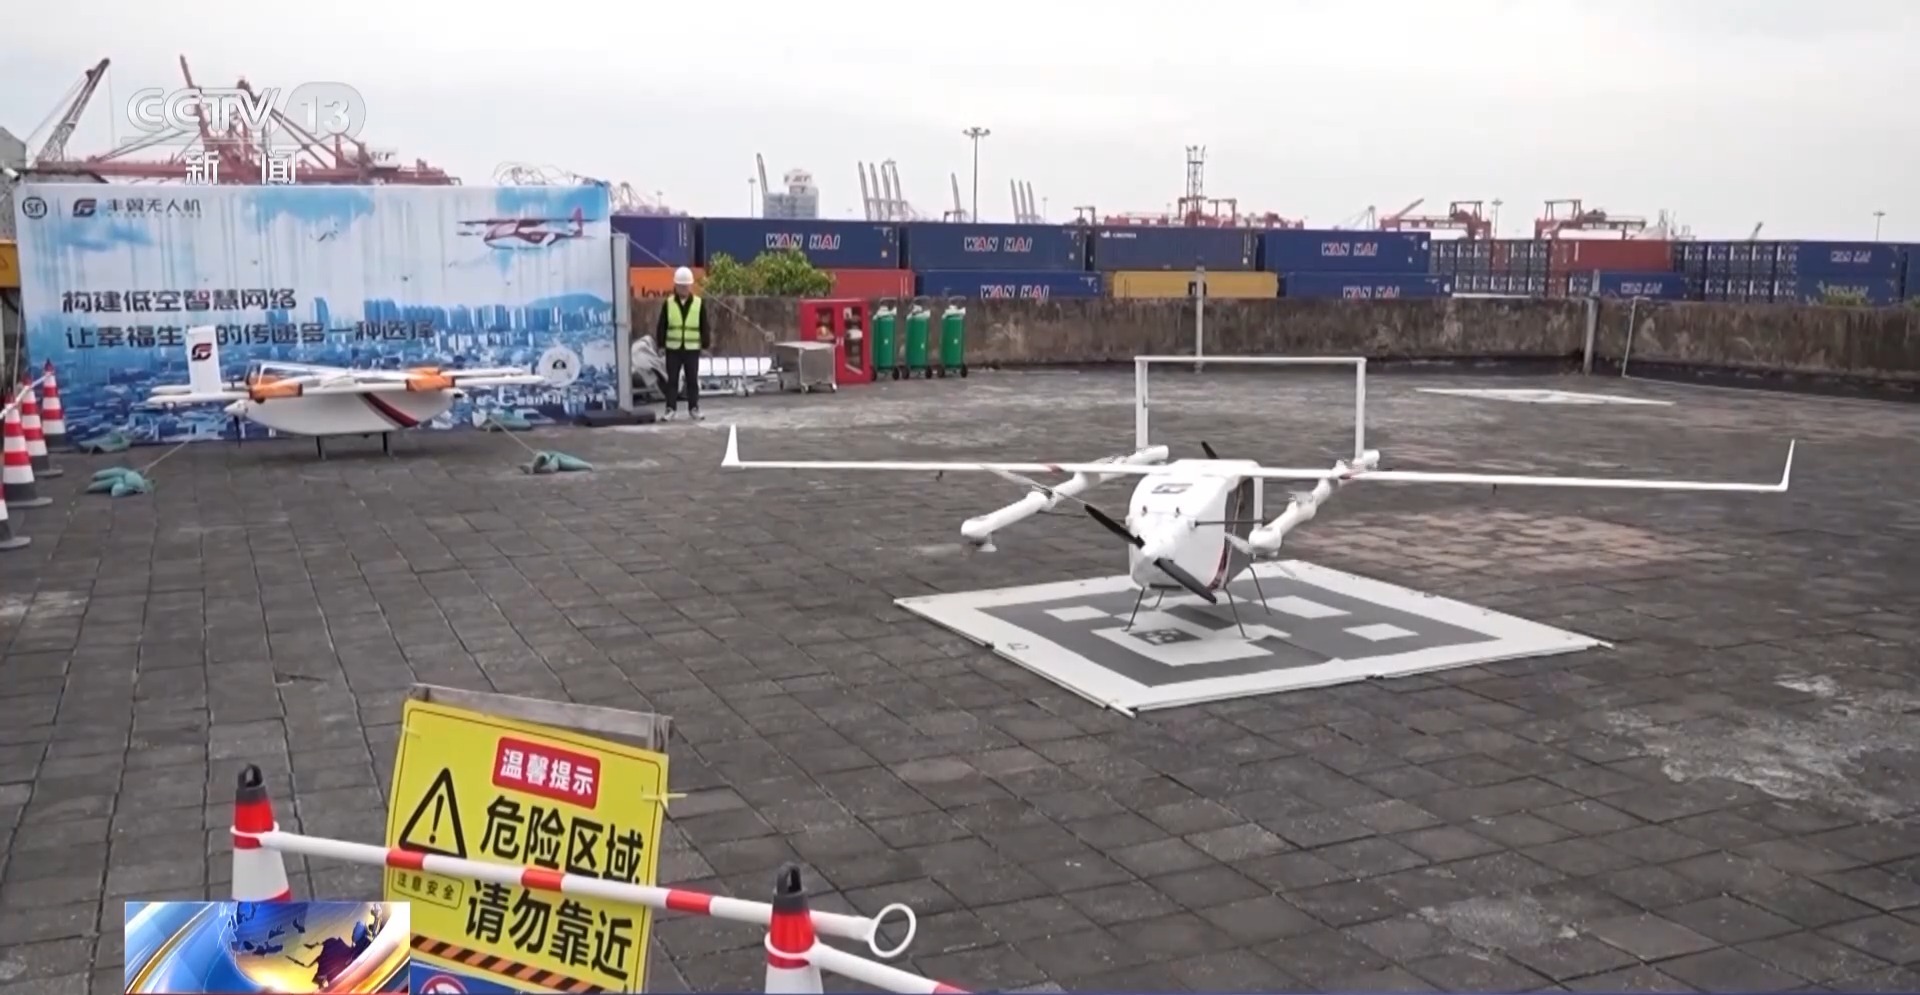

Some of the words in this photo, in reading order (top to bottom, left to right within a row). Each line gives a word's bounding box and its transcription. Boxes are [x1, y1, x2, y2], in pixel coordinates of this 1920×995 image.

[106, 198, 201, 213] 丰翼无人机
[766, 233, 803, 249] WAN
[809, 234, 841, 249] HAI
[964, 236, 998, 251] WAN
[1004, 237, 1033, 251] HAI
[1321, 243, 1349, 256] WAN
[62, 288, 297, 314] 构建低空智慧网络
[980, 284, 1015, 299] WAN
[1020, 284, 1050, 299] HAI
[65, 320, 435, 349] 让幸福生的传递多一种选择
[500, 748, 594, 796] 温馨提示
[480, 795, 643, 884] 危险区域
[397, 872, 455, 902] 注意安全
[465, 878, 632, 980] 请勿靠近
